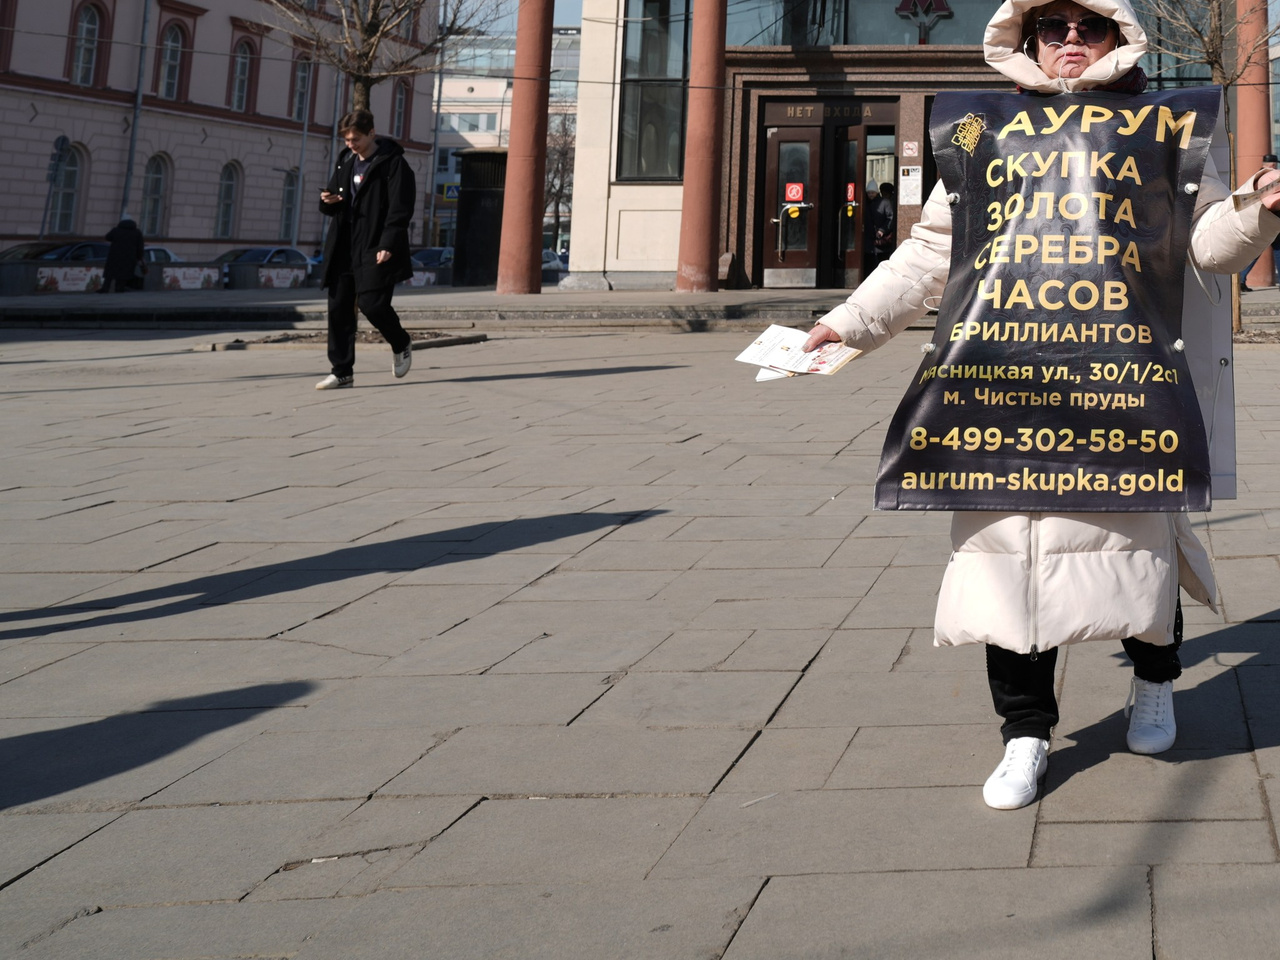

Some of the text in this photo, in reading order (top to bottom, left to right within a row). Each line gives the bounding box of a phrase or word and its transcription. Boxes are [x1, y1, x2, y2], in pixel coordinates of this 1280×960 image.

[787, 106, 872, 118] НЕТ ВХОДА
[997, 105, 1197, 150] АУРУМ
[986, 151, 1142, 188] СКУПКА
[986, 192, 1137, 232] ЗОЛОТА
[974, 235, 1142, 273] СЕРЕБРА
[976, 279, 1130, 311] ЧАСОВ
[950, 321, 1153, 344] БРИЛЛИАНТОВ
[1041, 365, 1081, 384] ул.,
[1089, 361, 1179, 385] 30/1/2с1
[943, 388, 1145, 410] м. Чистые пруды
[909, 426, 1179, 454] 8-499-302-58-50
[901, 466, 1185, 497] aurum-skupka.gold
